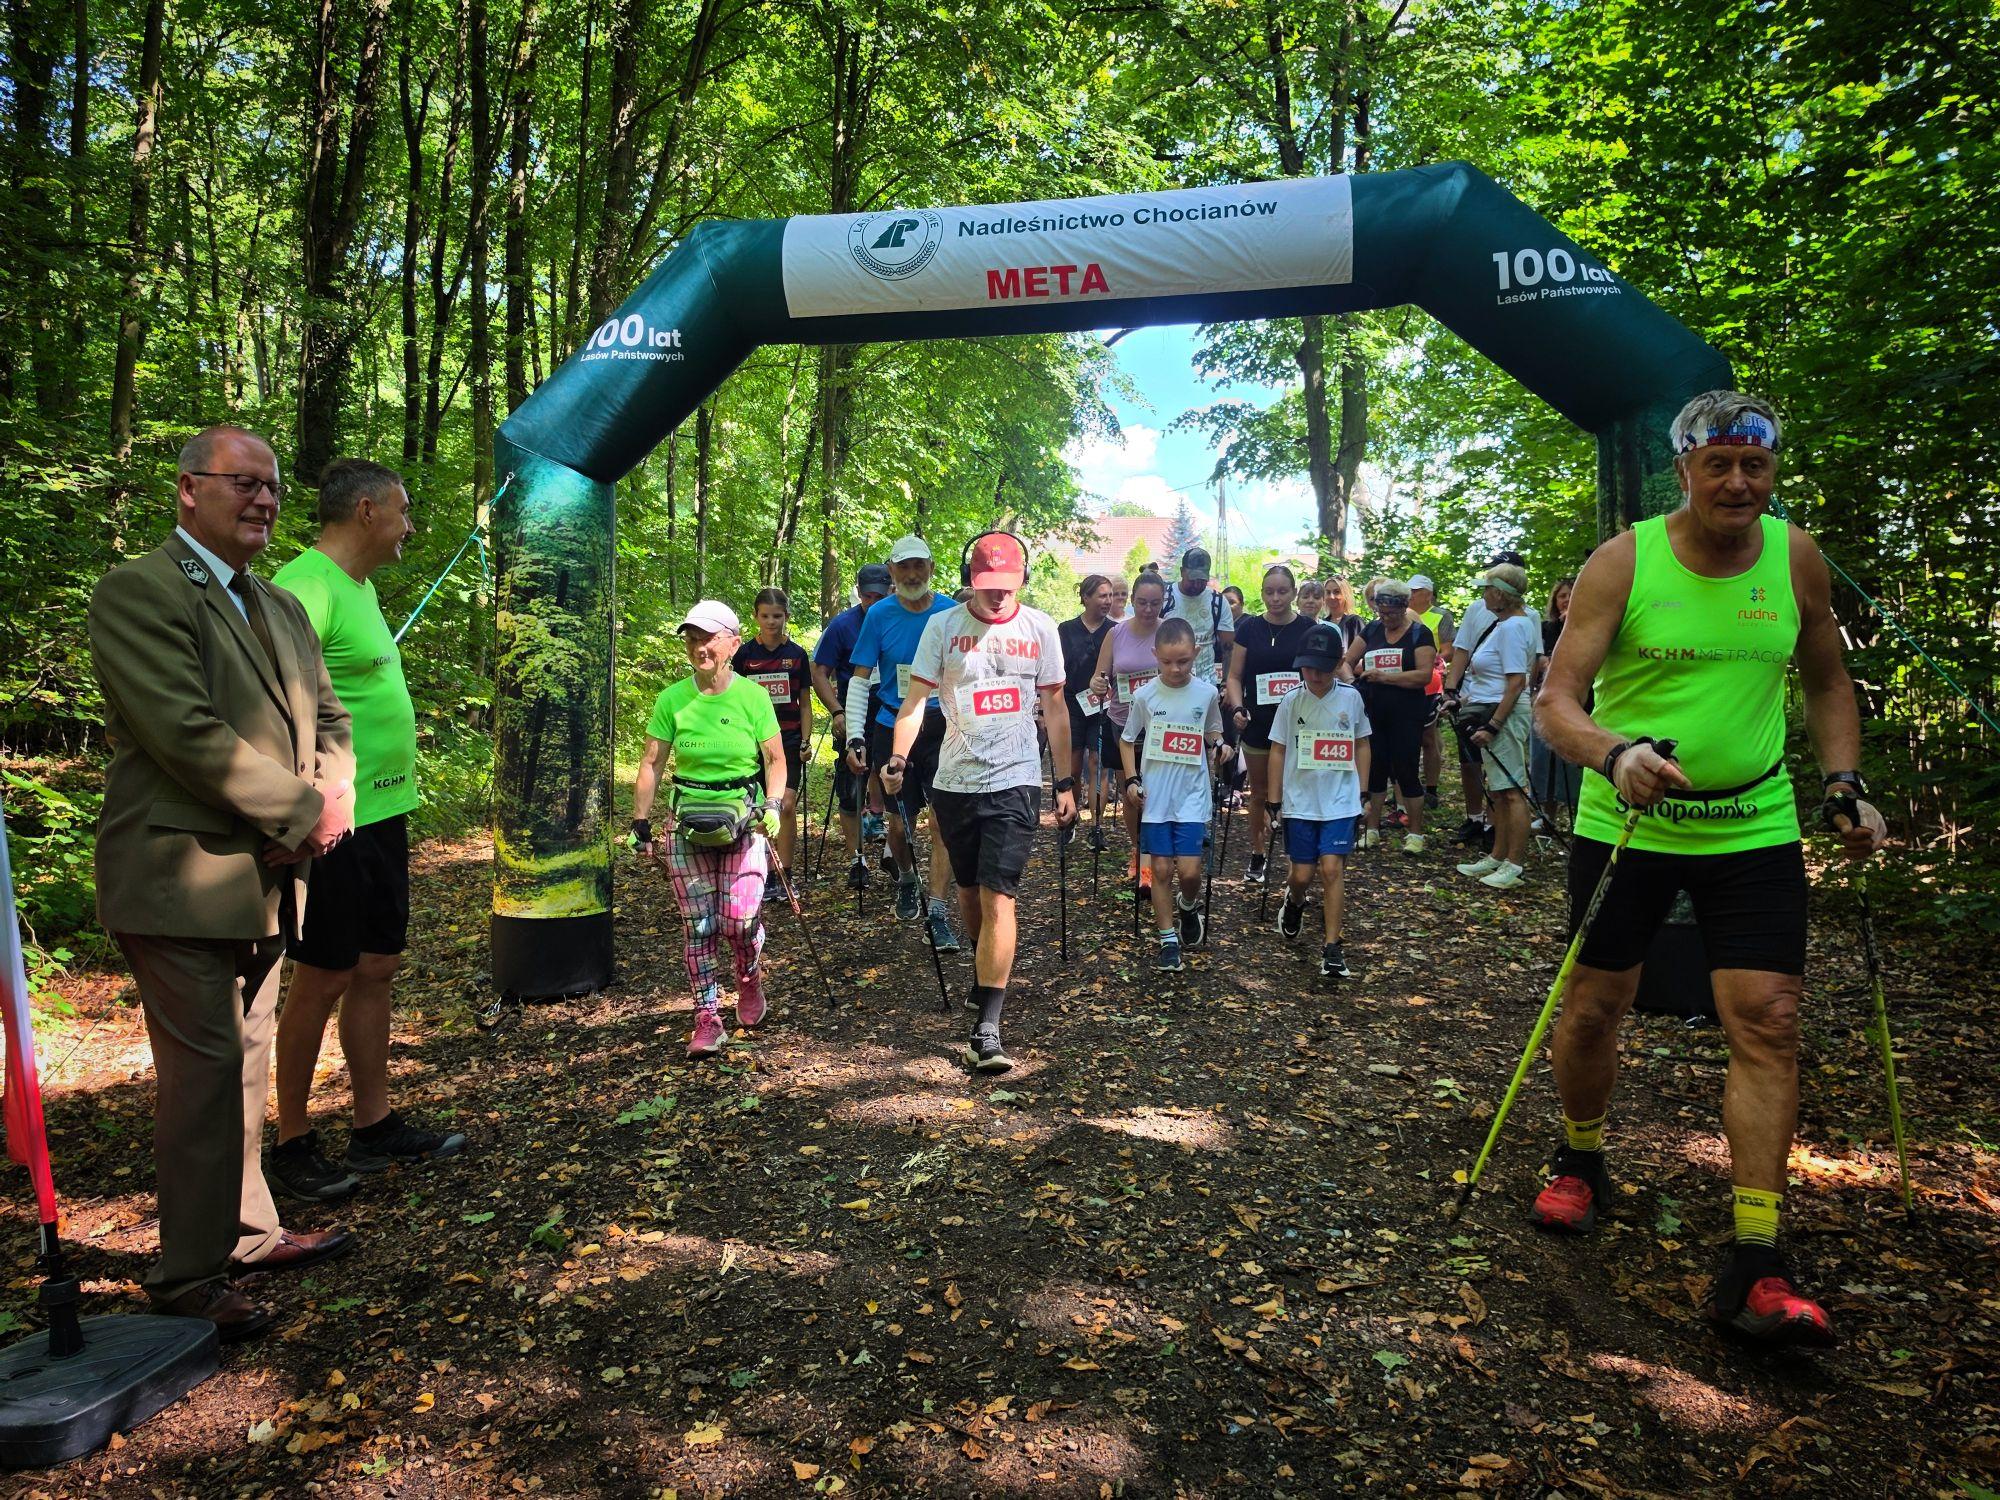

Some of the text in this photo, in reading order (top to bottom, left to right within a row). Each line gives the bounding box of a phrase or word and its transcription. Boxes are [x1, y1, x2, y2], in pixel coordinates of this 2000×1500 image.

[958, 210, 1125, 238] Nadleśnictwo
[1133, 201, 1278, 225] Chocianów
[1492, 248, 1615, 290] 100 lat
[986, 263, 1110, 300] META
[1496, 285, 1622, 305] Lasów Państwowych
[586, 313, 681, 351] 100 lat
[580, 349, 685, 363] Lasów Państwowych
[1737, 607, 1778, 622] rudna
[1378, 655, 1398, 666] 455
[1638, 647, 1784, 664] KGHM METRACO
[766, 684, 785, 695] 56
[980, 693, 1014, 711] 458
[1168, 736, 1197, 753] 452
[1319, 744, 1348, 758] 448
